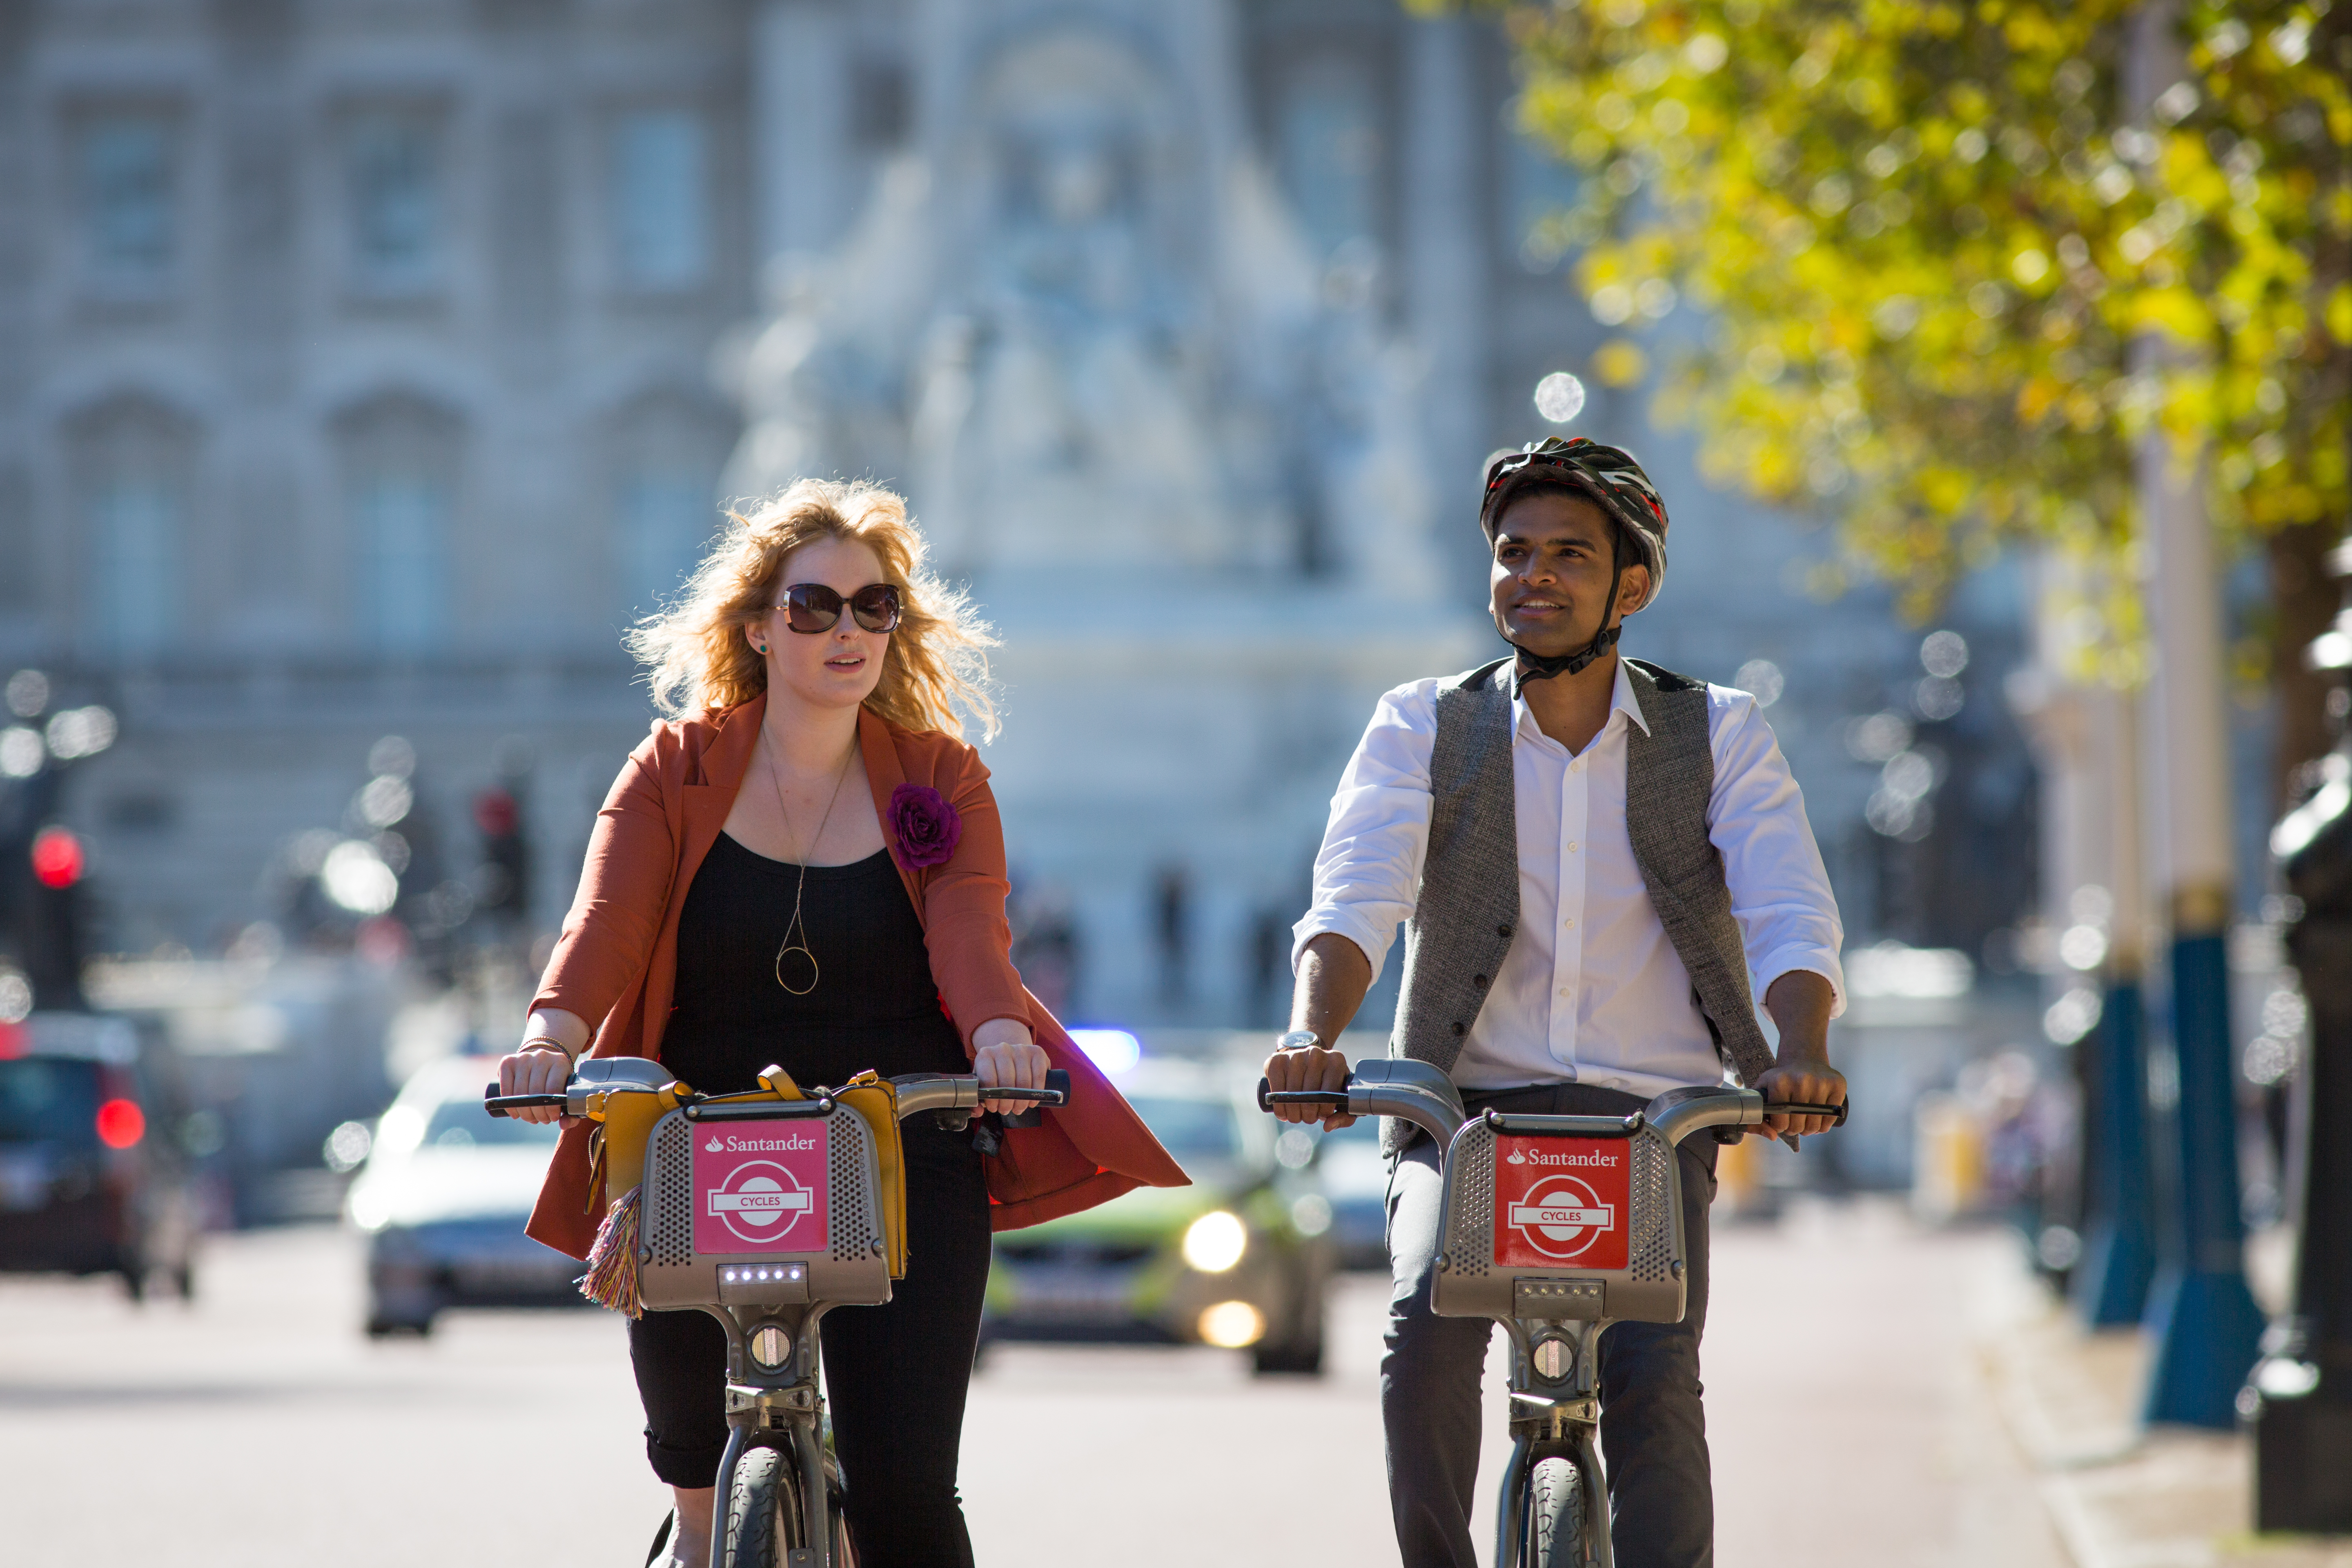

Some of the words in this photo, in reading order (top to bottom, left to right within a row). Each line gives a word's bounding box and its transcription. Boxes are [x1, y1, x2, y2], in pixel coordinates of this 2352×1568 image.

[727, 1134, 815, 1152] Santander
[1529, 1149, 1618, 1167] Santander
[740, 1196, 780, 1206] CYCLES
[1541, 1211, 1581, 1221] CYCLES
